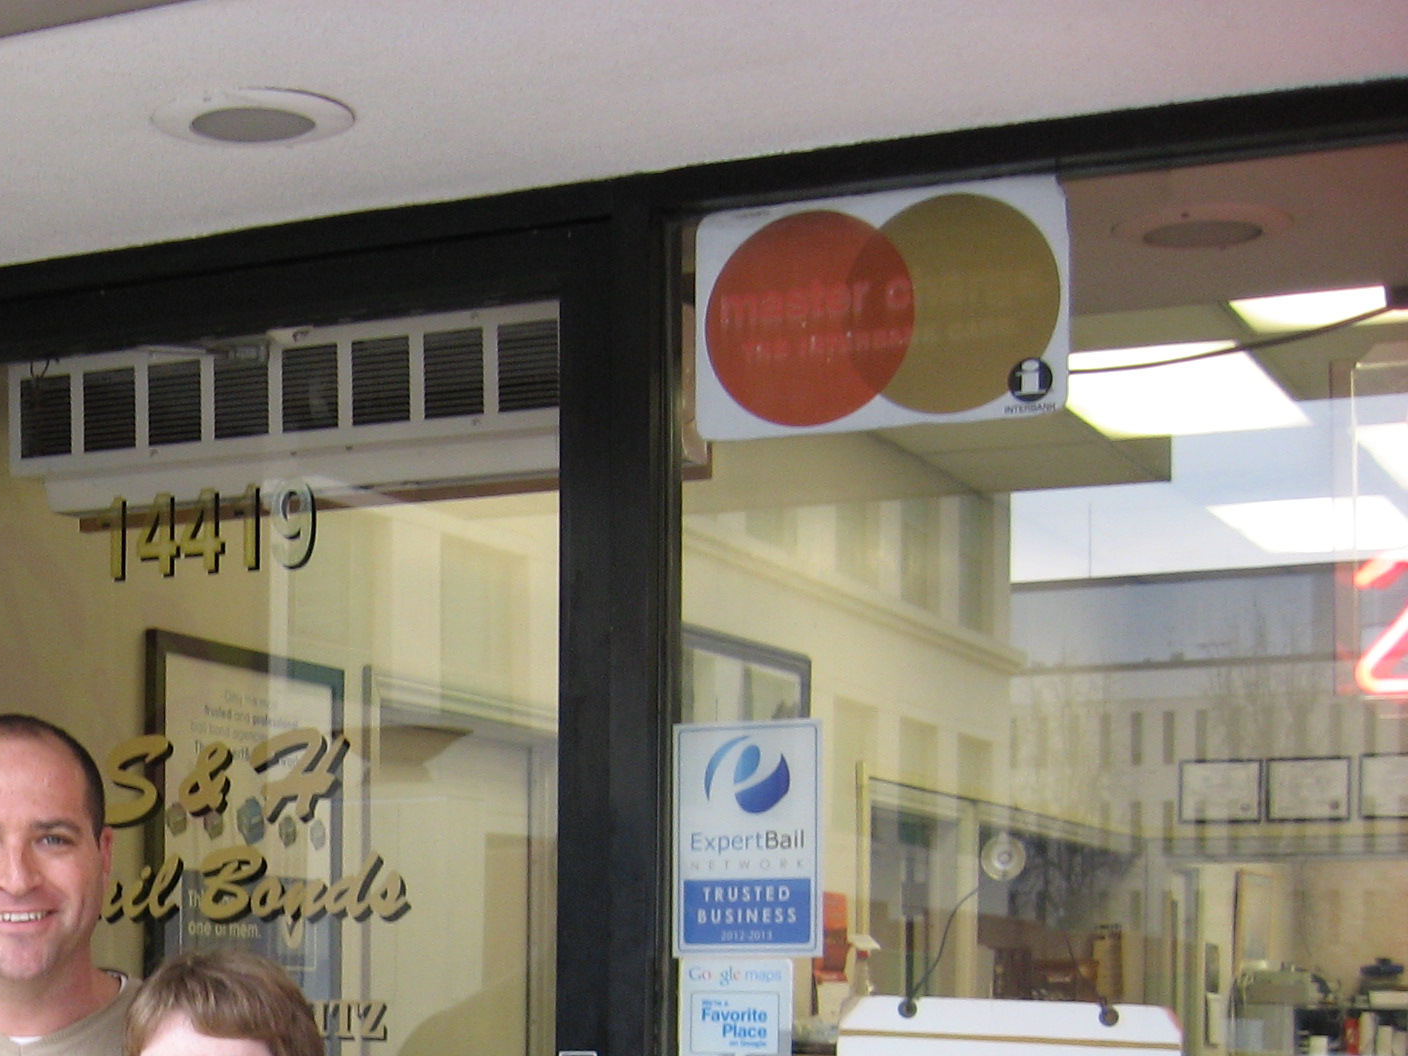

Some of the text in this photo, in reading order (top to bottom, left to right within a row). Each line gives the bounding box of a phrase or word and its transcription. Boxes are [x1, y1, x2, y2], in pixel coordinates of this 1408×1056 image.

[102, 478, 317, 581] 14419
[102, 733, 173, 828] S
[249, 727, 350, 823] H
[690, 829, 804, 854] ExpertBail
[200, 846, 411, 922] Bonds
[703, 885, 790, 902] TRUSTED
[697, 907, 797, 924] BUSINESS
[701, 1007, 768, 1022] Favorite
[723, 1023, 767, 1038] Place
